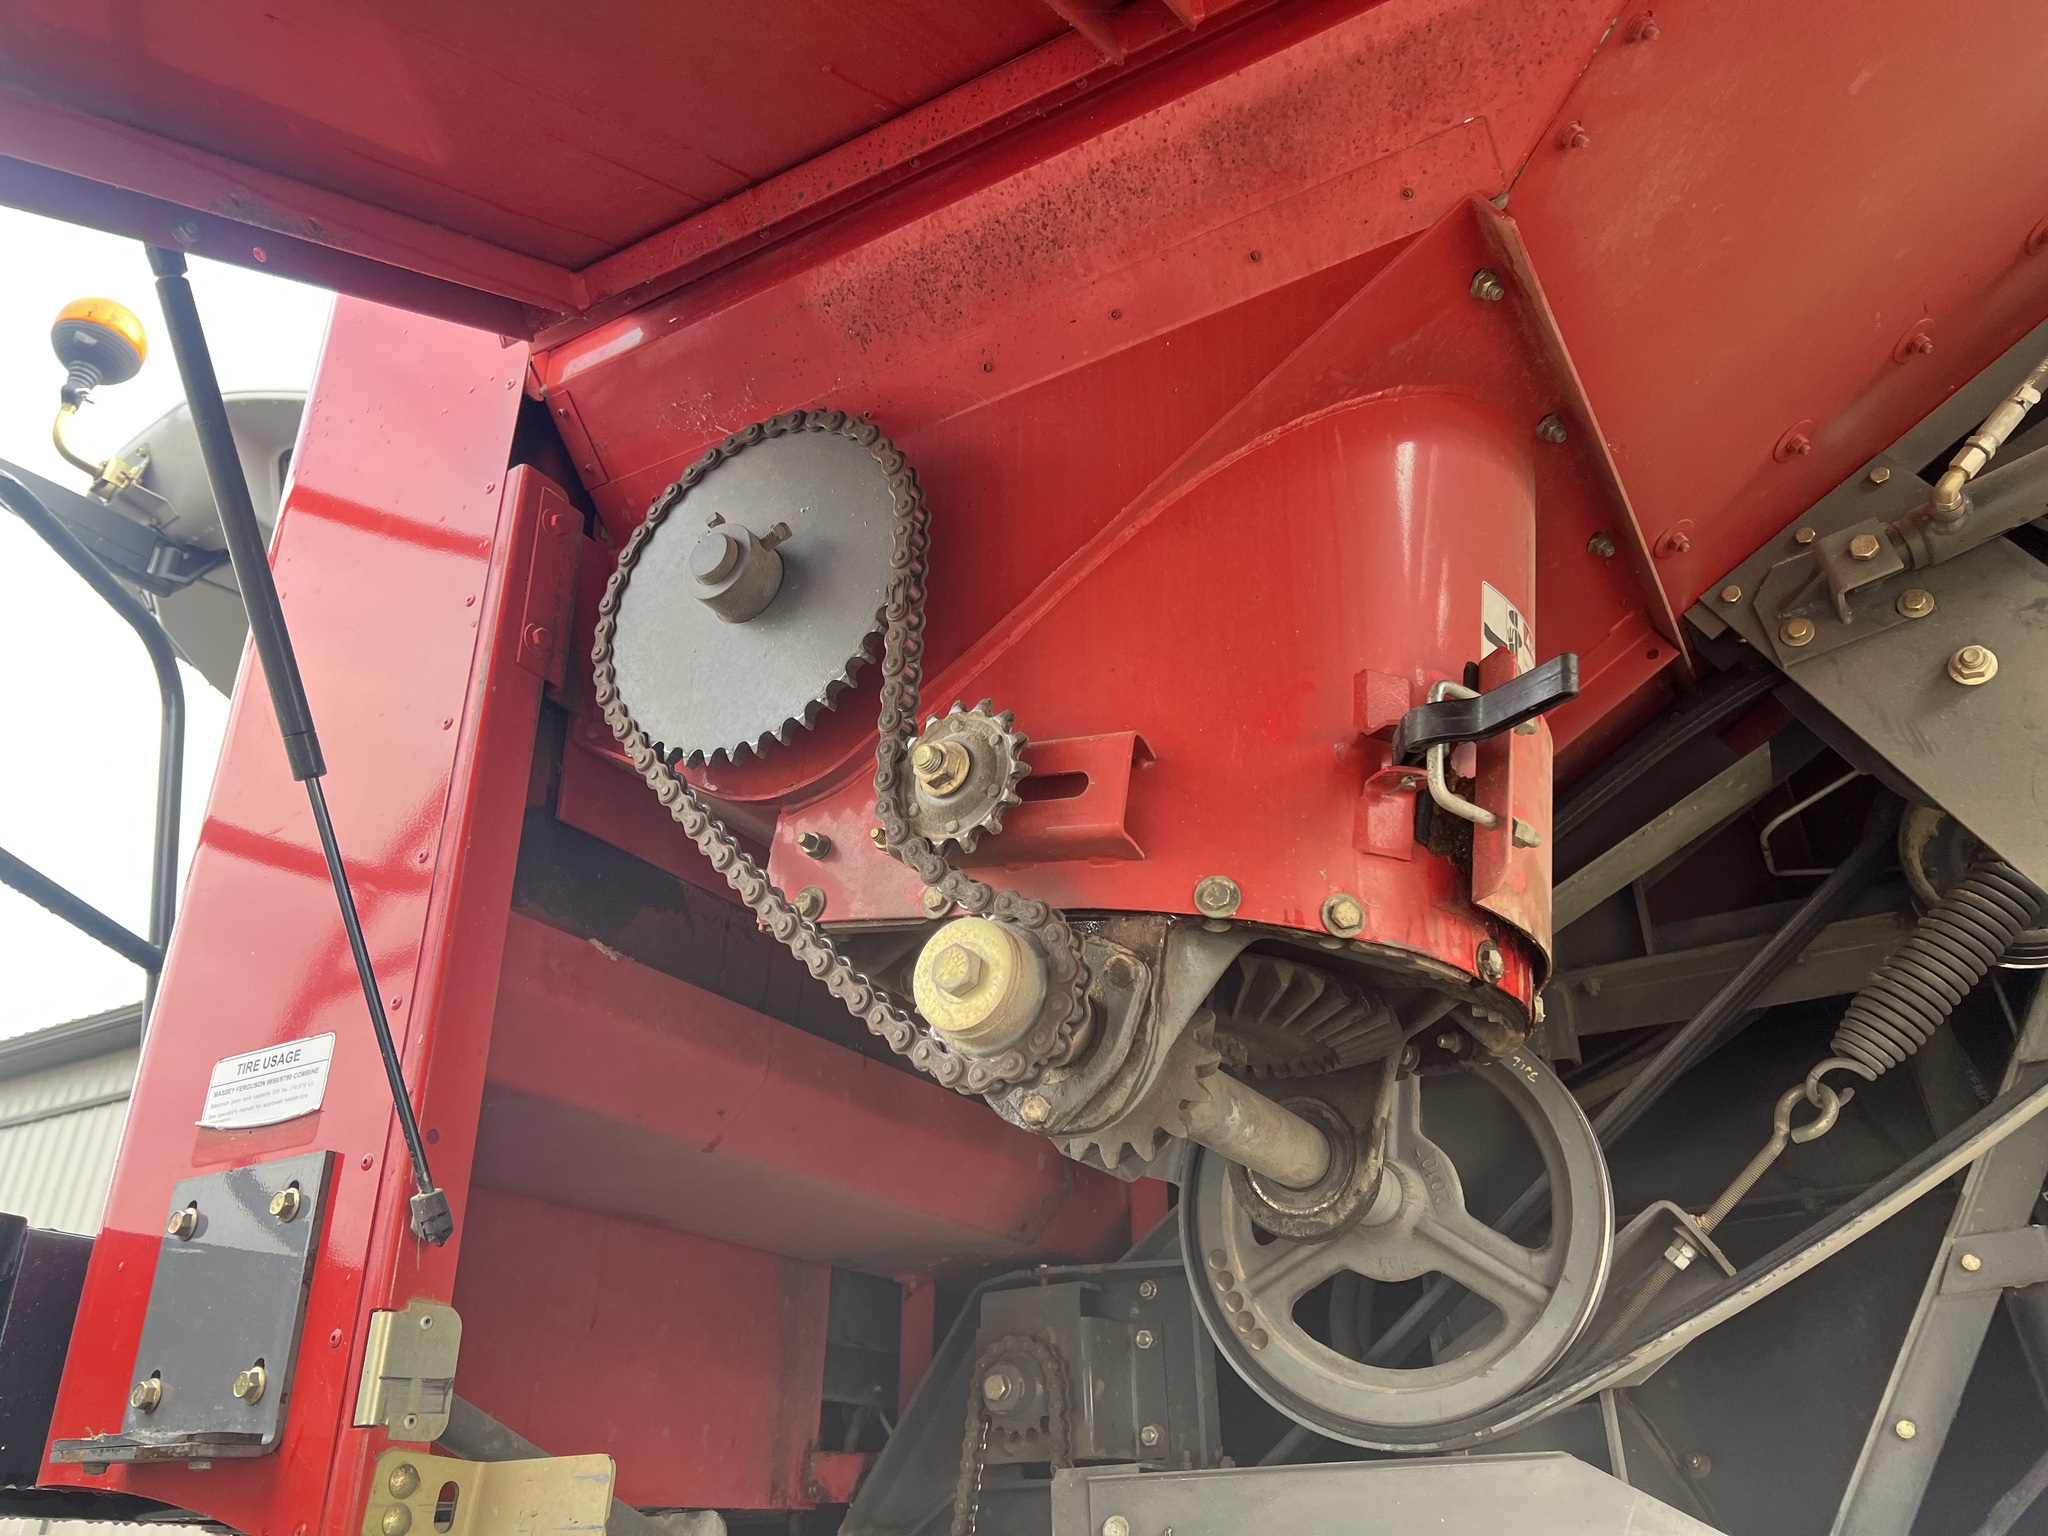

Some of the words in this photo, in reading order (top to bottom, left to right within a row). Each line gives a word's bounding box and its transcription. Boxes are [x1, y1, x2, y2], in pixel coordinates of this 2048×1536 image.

[237, 1060, 261, 1076] TIRE
[263, 1049, 302, 1069] USAGE
[213, 1087, 236, 1098] MASSEY
[236, 1080, 266, 1093] FERGUSON
[293, 1067, 320, 1079] COMBINE
